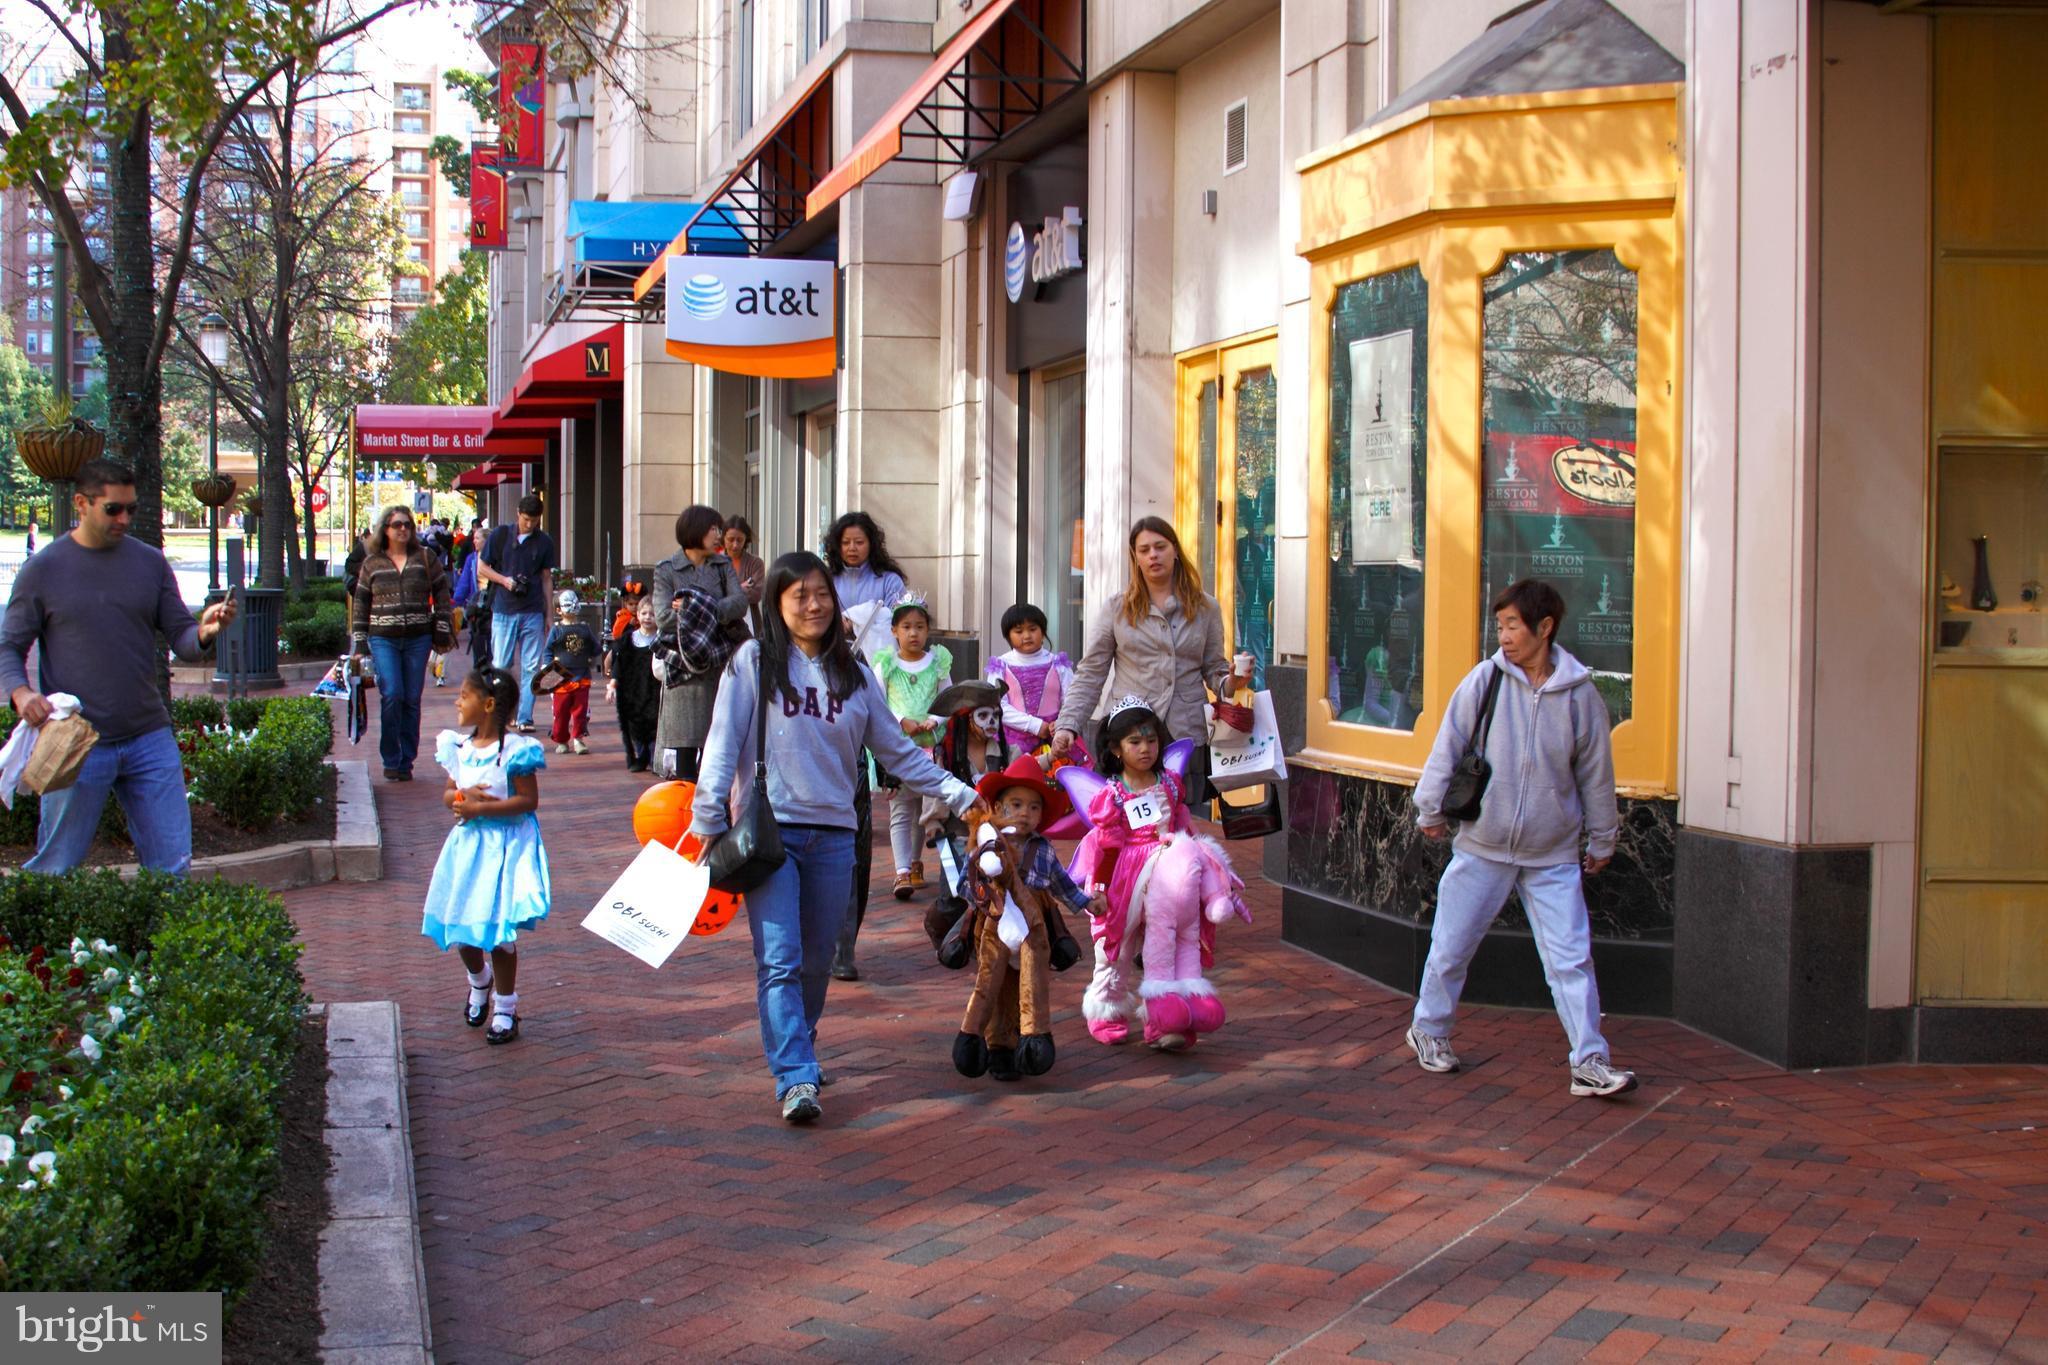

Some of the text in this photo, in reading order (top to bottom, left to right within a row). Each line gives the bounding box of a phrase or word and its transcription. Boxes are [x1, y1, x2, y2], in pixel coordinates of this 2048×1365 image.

[475, 223, 487, 237] M
[632, 241, 701, 257] HYT
[1031, 206, 1083, 283] at&t
[735, 280, 820, 317] at&t
[586, 347, 611, 373] M
[363, 433, 484, 448] Market Street Bar & Grill
[300, 493, 327, 506] SOP
[1487, 487, 1538, 499] RESTON
[1532, 554, 1584, 566] RESTON
[1555, 567, 1584, 575] CENTER
[1578, 621, 1632, 634] RESTON
[1221, 754, 1243, 766] OBI
[1132, 802, 1152, 819] 15
[612, 901, 642, 919] OBI
[638, 918, 670, 938] SUSHI
